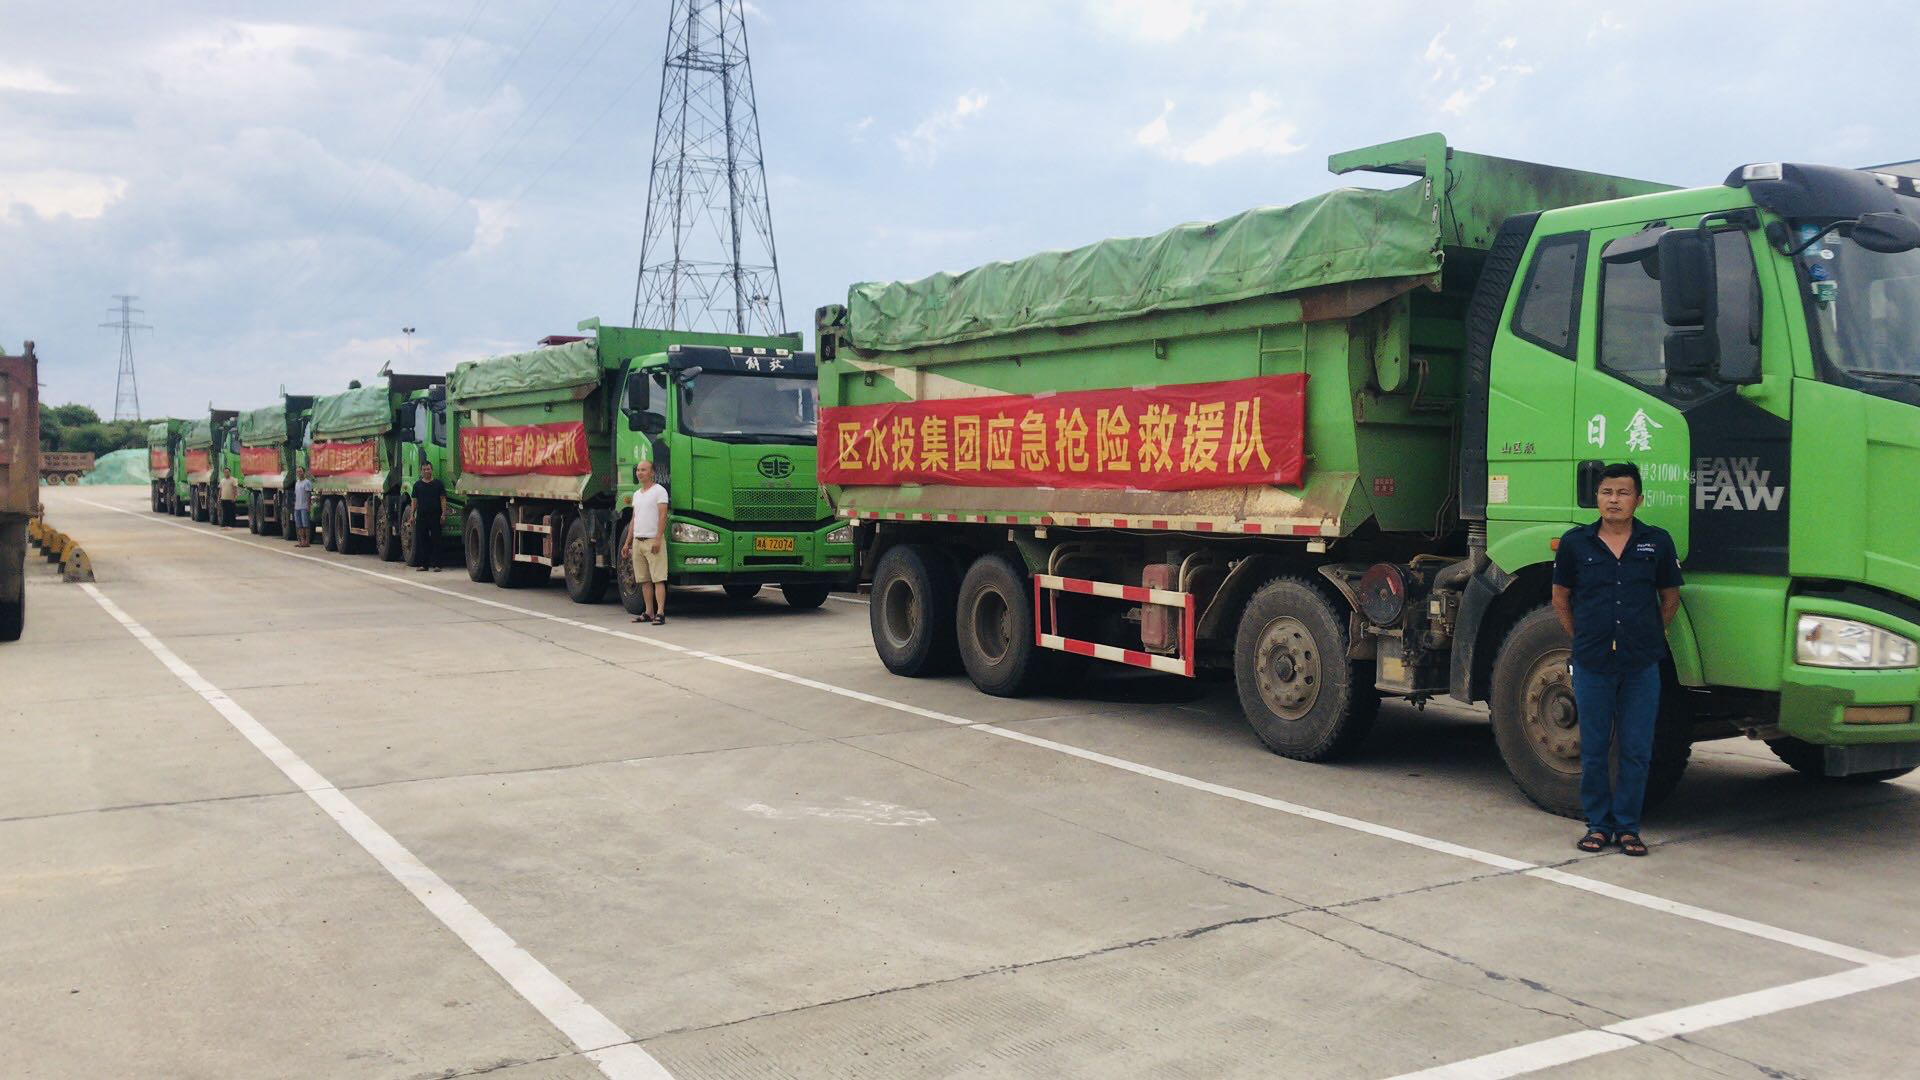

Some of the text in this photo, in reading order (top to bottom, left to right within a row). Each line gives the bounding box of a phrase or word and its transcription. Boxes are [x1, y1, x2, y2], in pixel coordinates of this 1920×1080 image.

[838, 397, 1272, 473] 区水投集团应急抢险救援队
[1695, 486, 1785, 511] FAW
